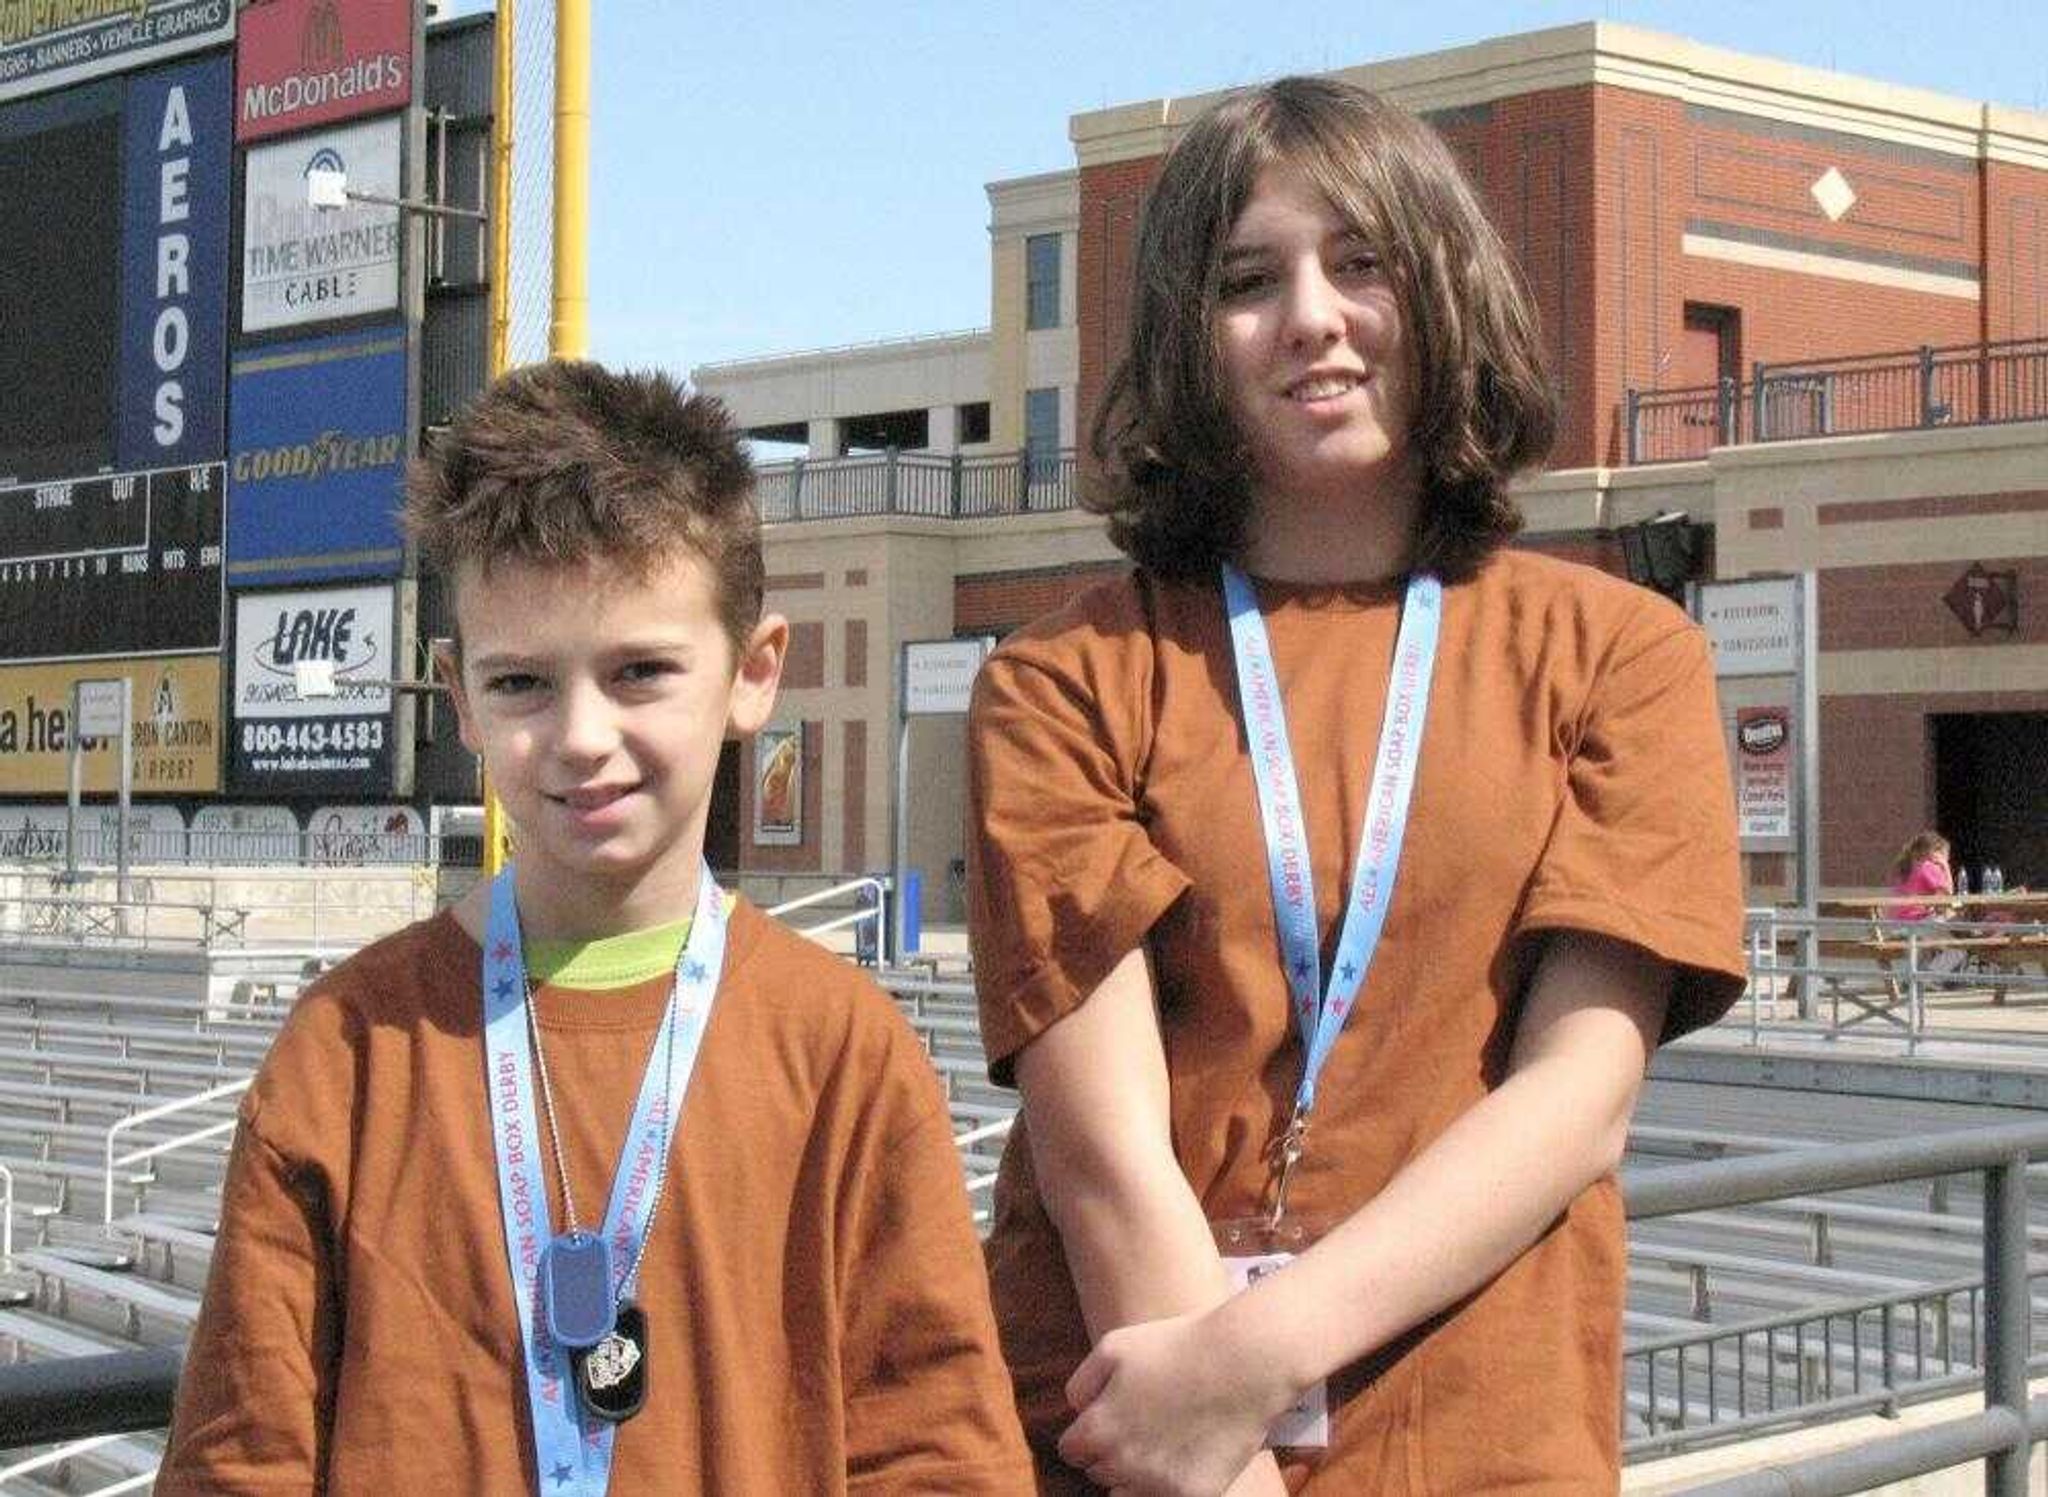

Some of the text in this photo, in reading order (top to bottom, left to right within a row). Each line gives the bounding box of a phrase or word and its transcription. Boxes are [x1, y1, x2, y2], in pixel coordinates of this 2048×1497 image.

[36, 34, 92, 69] BANNERS
[99, 20, 153, 51] VEHICLE
[156, 4, 221, 37] GRAPHICS
[243, 55, 402, 122] McDonald's
[152, 86, 194, 446] AEROS
[247, 223, 399, 277] TIME WARNER
[285, 273, 358, 306] CABLE
[233, 430, 401, 482] GOODYEAR
[34, 485, 73, 509] STRIKE
[112, 477, 135, 500] OUT
[96, 556, 108, 575] 10
[122, 552, 149, 573] RUNS
[163, 549, 186, 570] HITS
[273, 608, 356, 665] LAKE
[166, 720, 213, 748] CANTON
[243, 720, 384, 752] 800-443-4583
[1391, 691, 1413, 727] BOX
[1384, 727, 1406, 770] SOAP
[1367, 775, 1400, 865] AMERICAN
[1282, 848, 1305, 908] DERBY
[498, 1050, 520, 1114] DERBY
[503, 1118, 525, 1165] BOX
[510, 1171, 534, 1228] SOAP
[612, 1142, 657, 1253] AMERICAN
